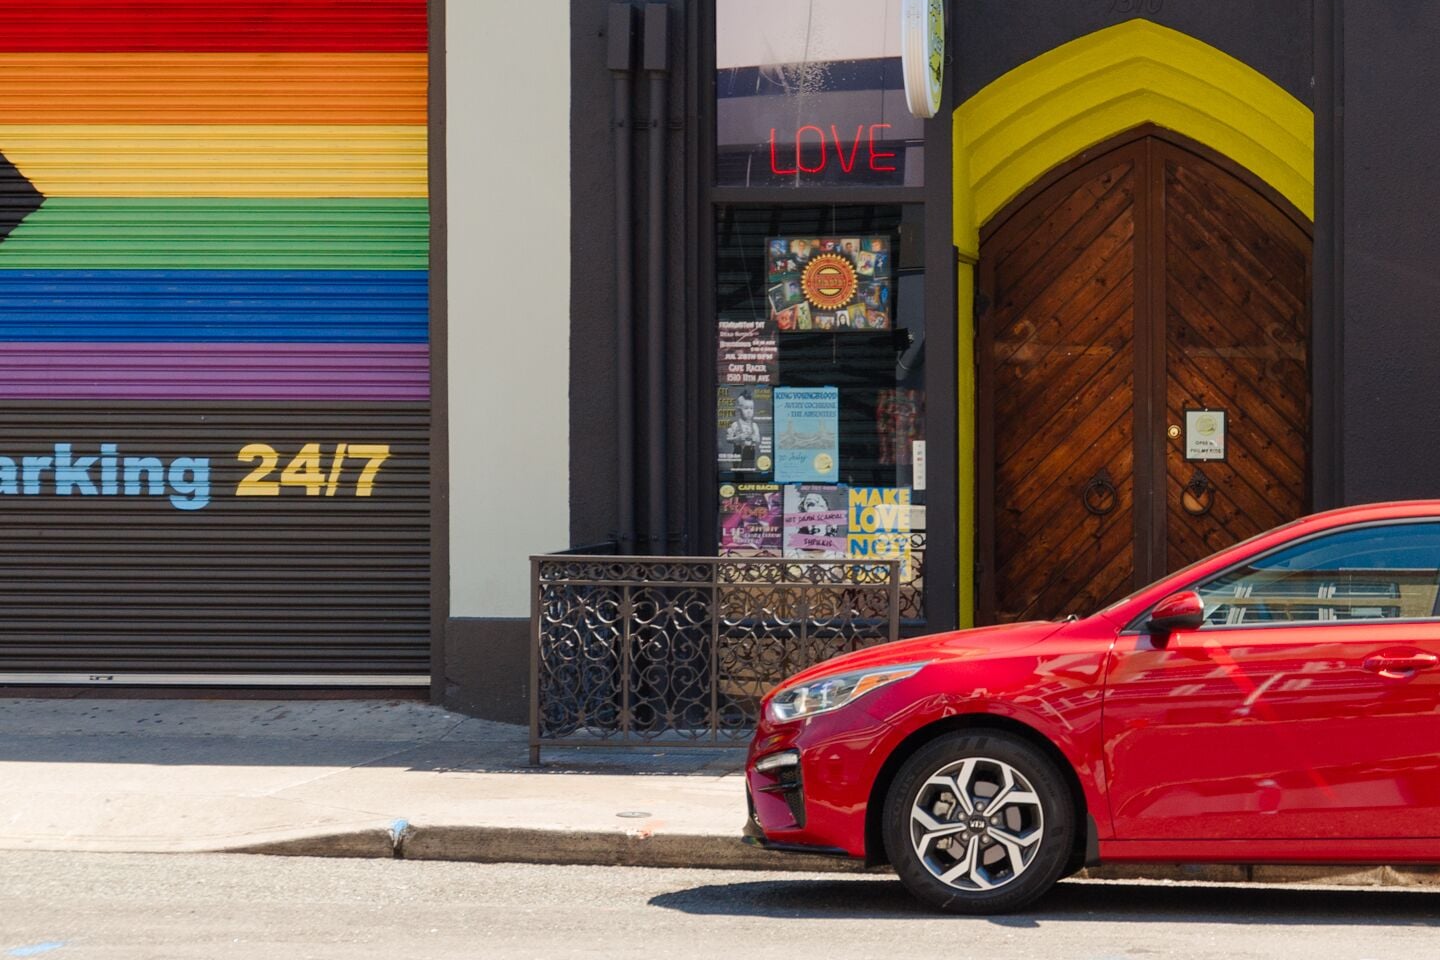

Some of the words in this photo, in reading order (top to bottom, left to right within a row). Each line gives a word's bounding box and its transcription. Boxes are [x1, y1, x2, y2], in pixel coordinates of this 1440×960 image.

[769, 123, 897, 176] LOVE
[234, 442, 392, 497] 24/7
[849, 488, 911, 506] MAKE
[849, 506, 911, 533] LOVE
[850, 538, 908, 556] NOT
[969, 820, 986, 828] KIA
